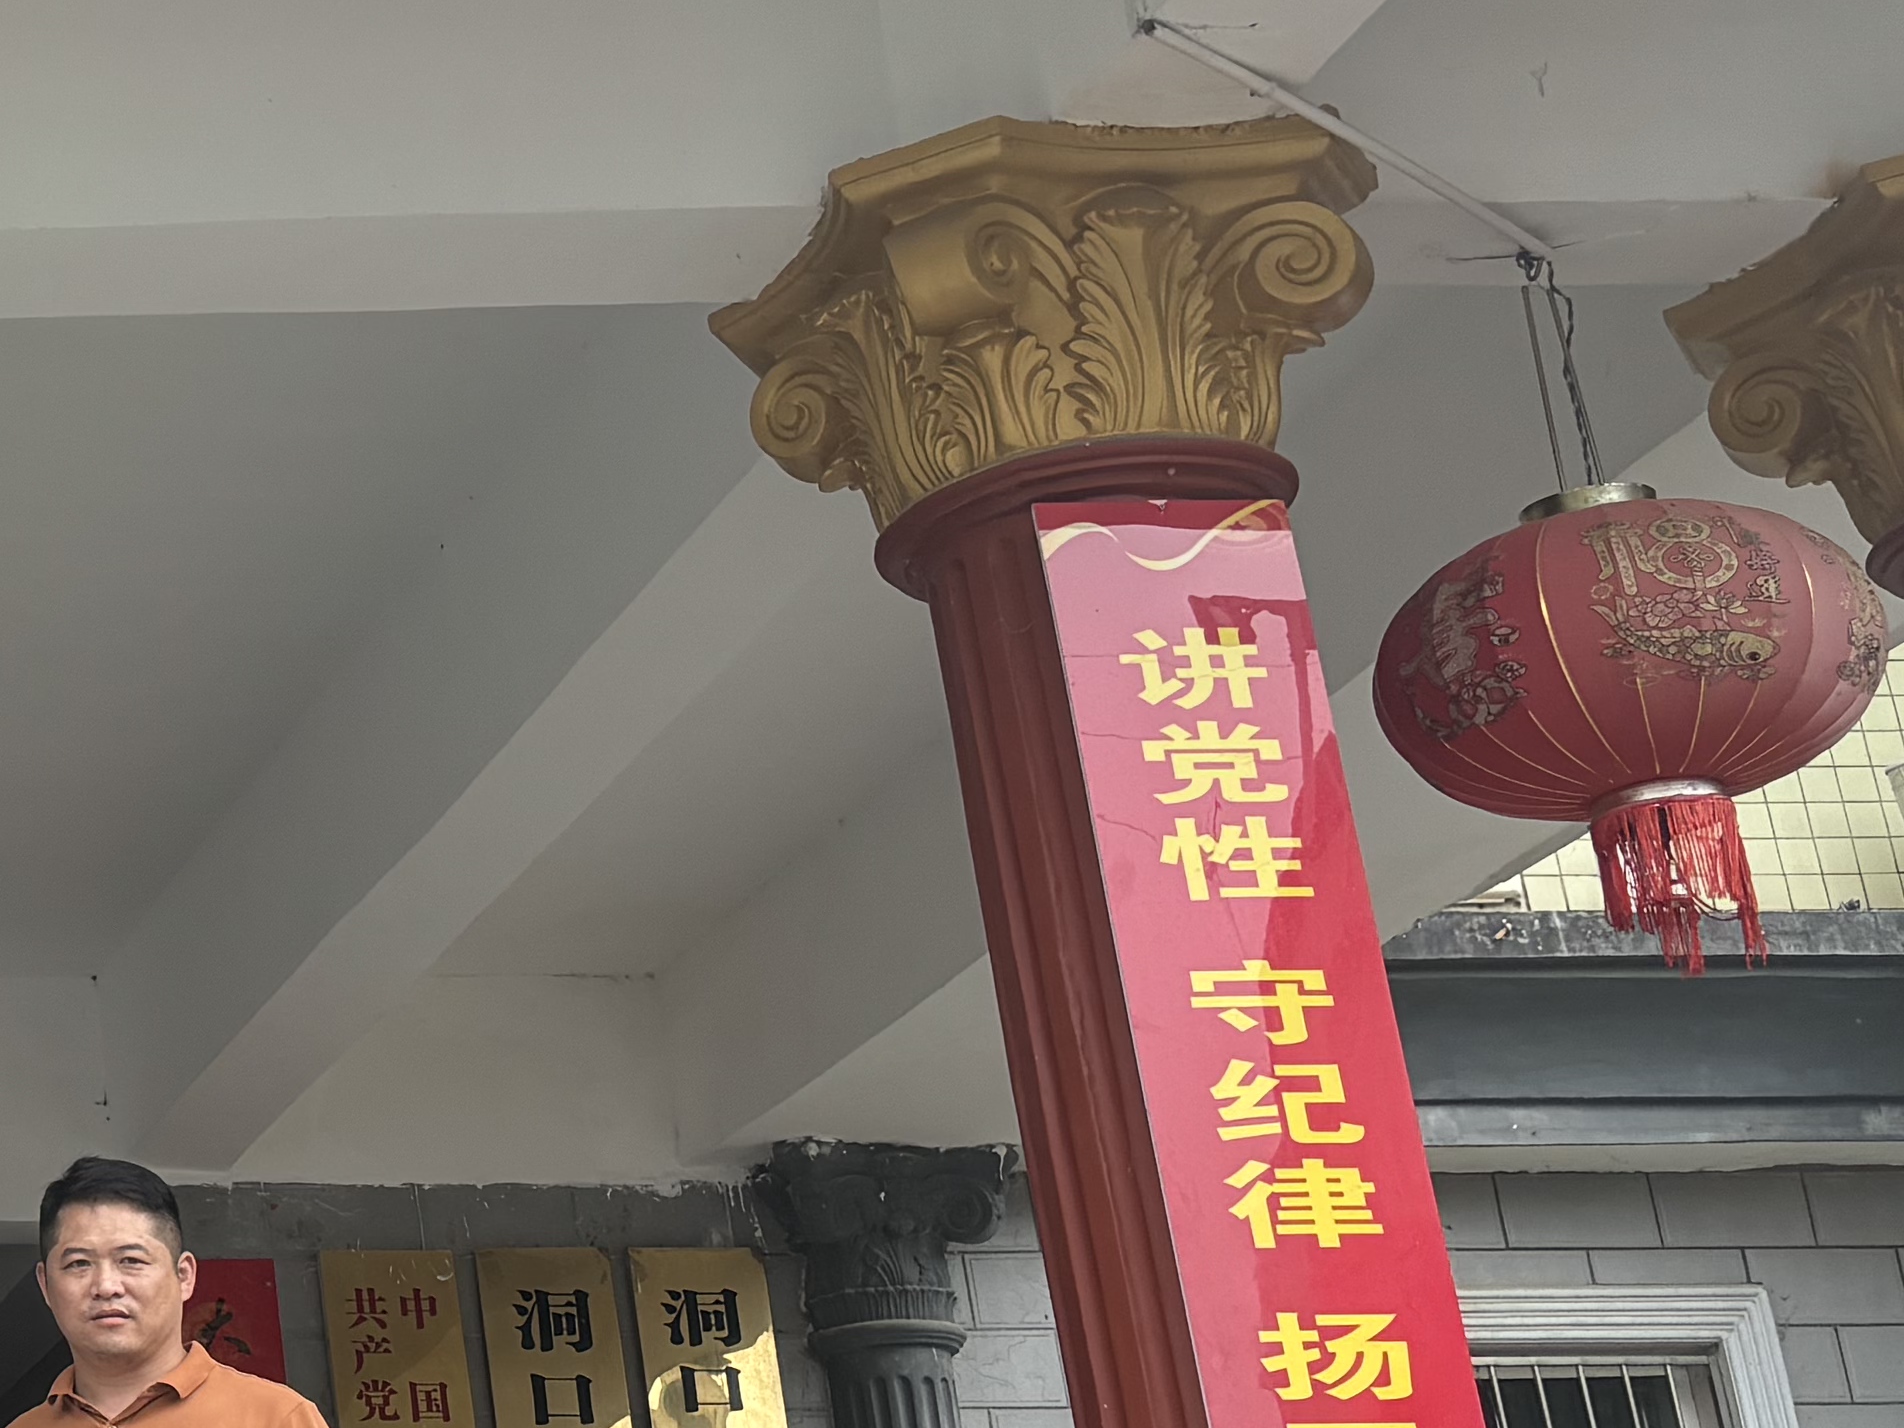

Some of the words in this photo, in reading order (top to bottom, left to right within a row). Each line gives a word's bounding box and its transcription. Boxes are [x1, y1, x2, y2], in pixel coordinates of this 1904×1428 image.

[1120, 627, 1314, 901] 讲党性
[1190, 959, 1384, 1250] 守纪律
